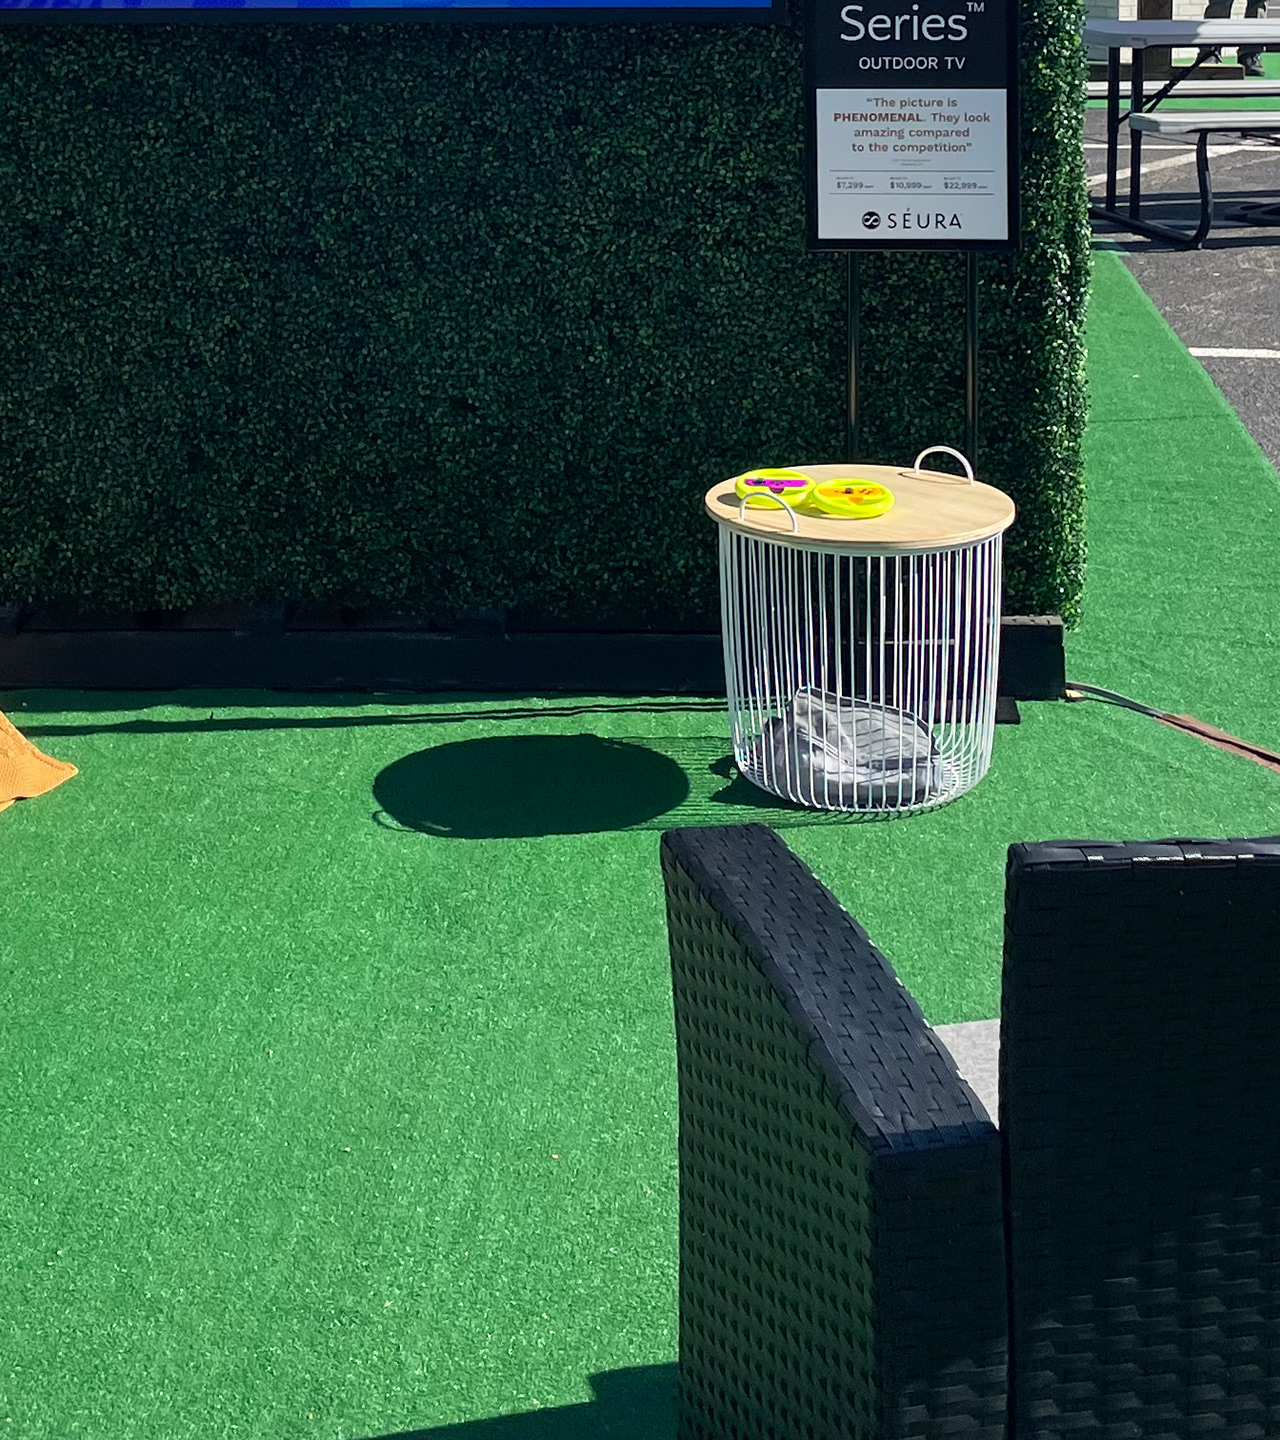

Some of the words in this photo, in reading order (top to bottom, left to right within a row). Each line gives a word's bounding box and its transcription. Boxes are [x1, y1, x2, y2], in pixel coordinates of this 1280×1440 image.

[858, 56, 939, 70] OUTDOOR
[944, 56, 966, 70] TV
[899, 97, 944, 110] picture
[947, 97, 958, 108] is
[930, 112, 961, 125] They
[964, 112, 991, 123] look
[853, 127, 906, 140] amazing
[908, 127, 970, 140] compared
[851, 142, 865, 152] to
[868, 142, 889, 152] the
